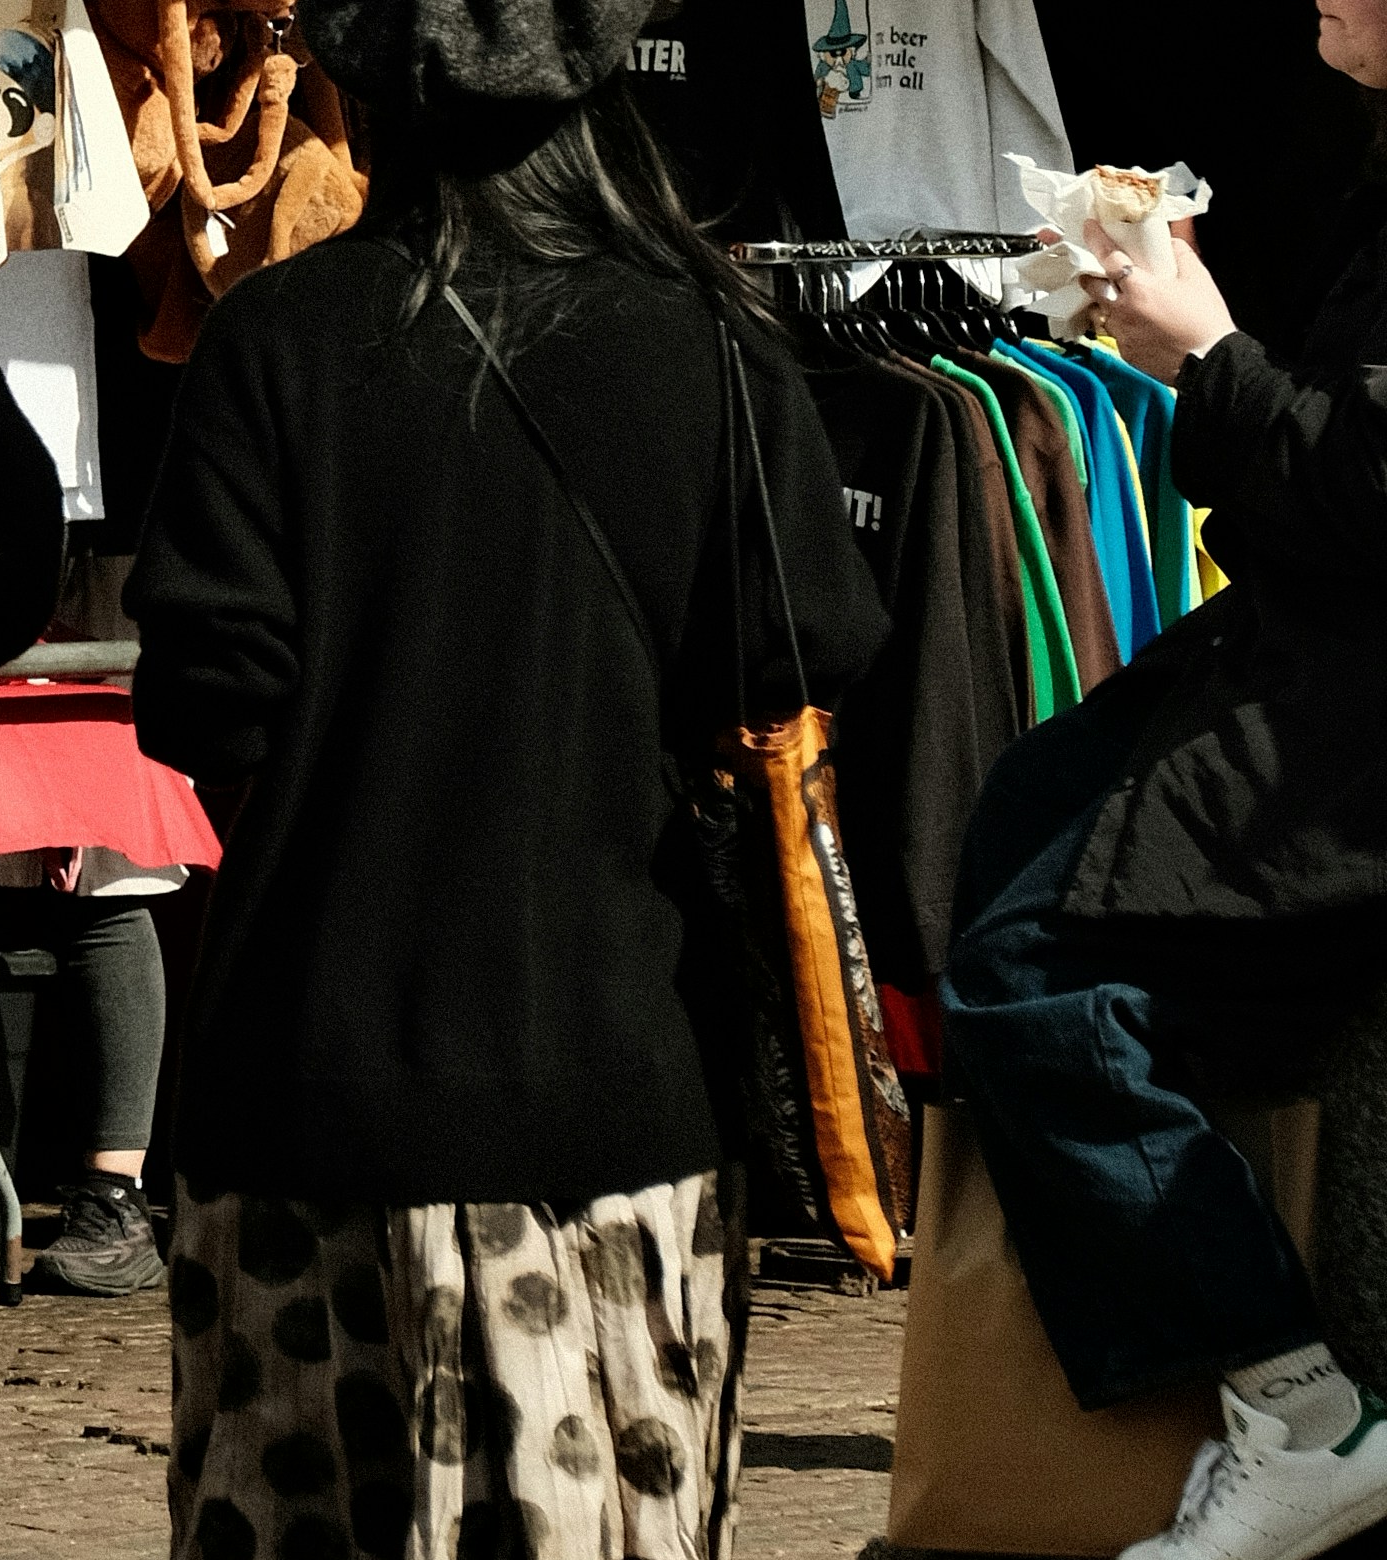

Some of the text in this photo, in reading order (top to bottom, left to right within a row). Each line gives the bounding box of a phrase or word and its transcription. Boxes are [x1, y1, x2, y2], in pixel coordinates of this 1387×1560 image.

[890, 26, 928, 48] beer
[885, 49, 917, 69] rule
[899, 71, 924, 91] all
